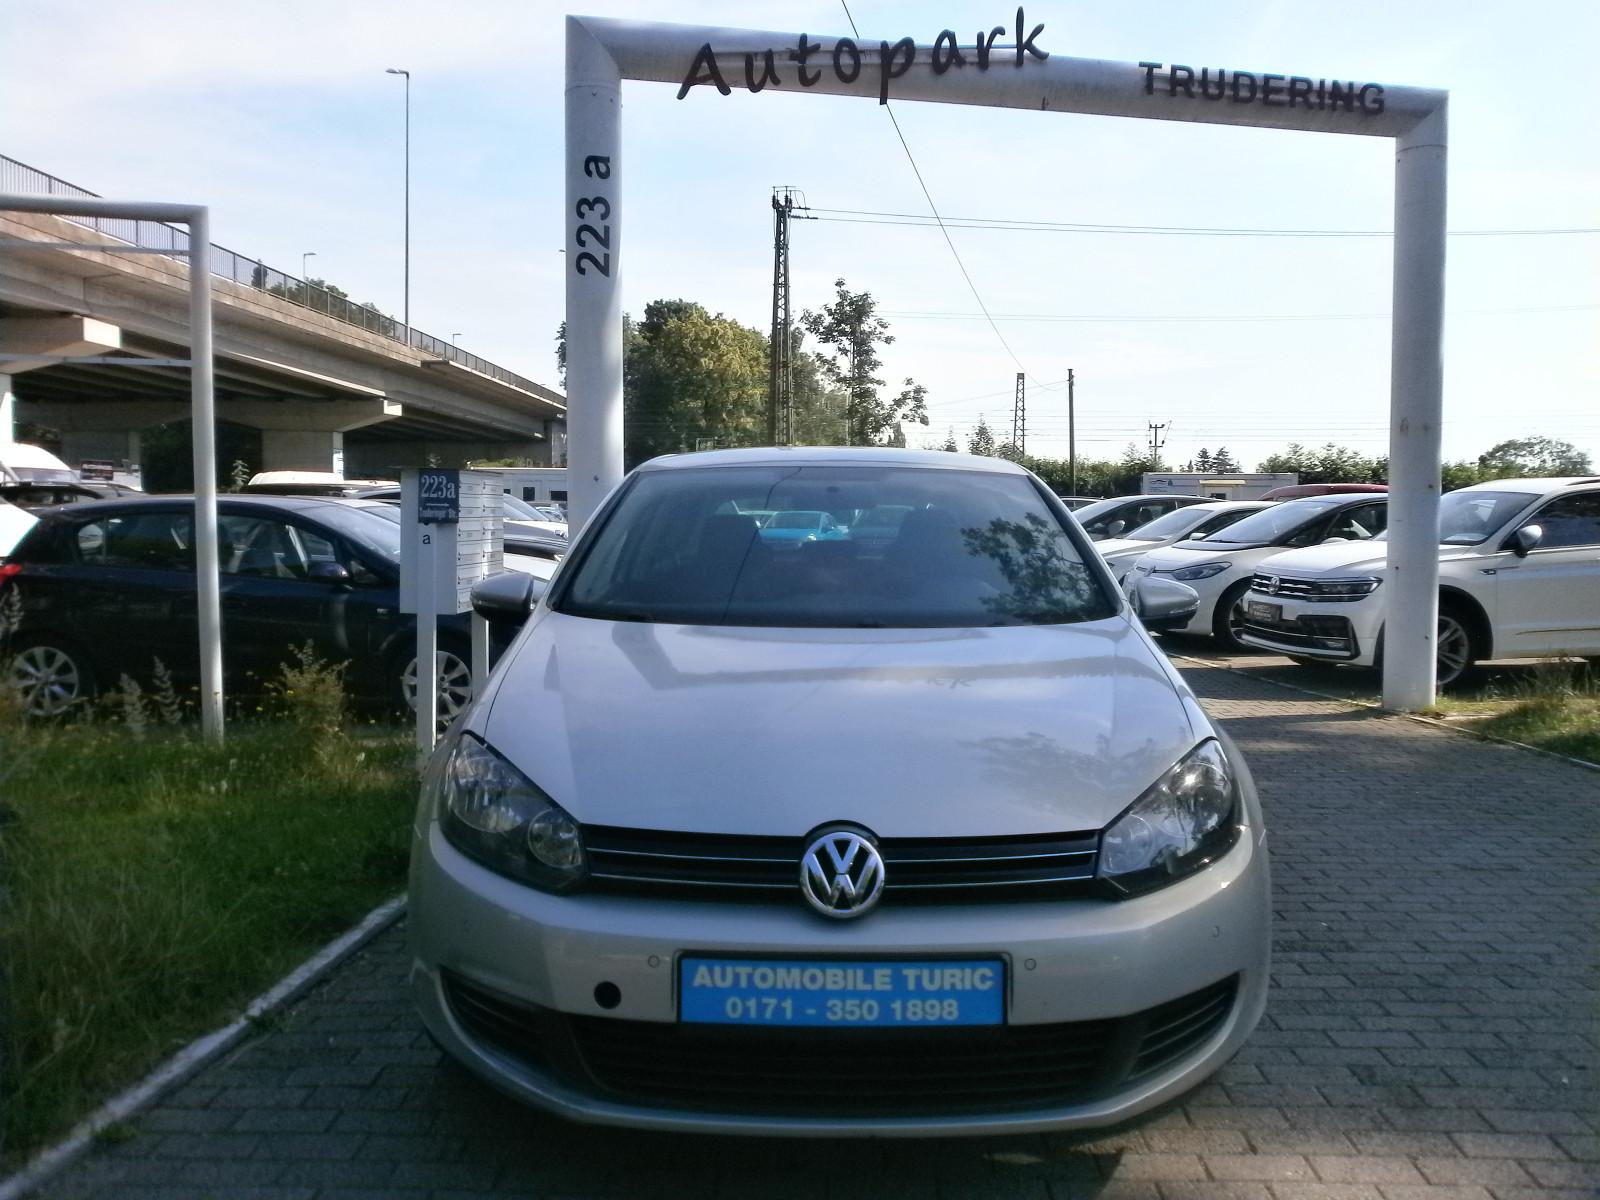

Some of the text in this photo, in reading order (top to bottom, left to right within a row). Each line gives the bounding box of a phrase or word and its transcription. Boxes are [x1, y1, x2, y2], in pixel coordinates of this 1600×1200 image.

[676, 6, 1050, 105] Autopark
[1138, 60, 1385, 115] TRUDERING
[575, 154, 611, 278] 223 a
[420, 475, 456, 499] 223a
[422, 534, 432, 545] a
[801, 832, 885, 918] VW
[692, 965, 995, 991] AUTOMOBILE TURIC
[725, 996, 793, 1020] 0171
[825, 998, 880, 1021] 350
[890, 998, 960, 1022] 1898
